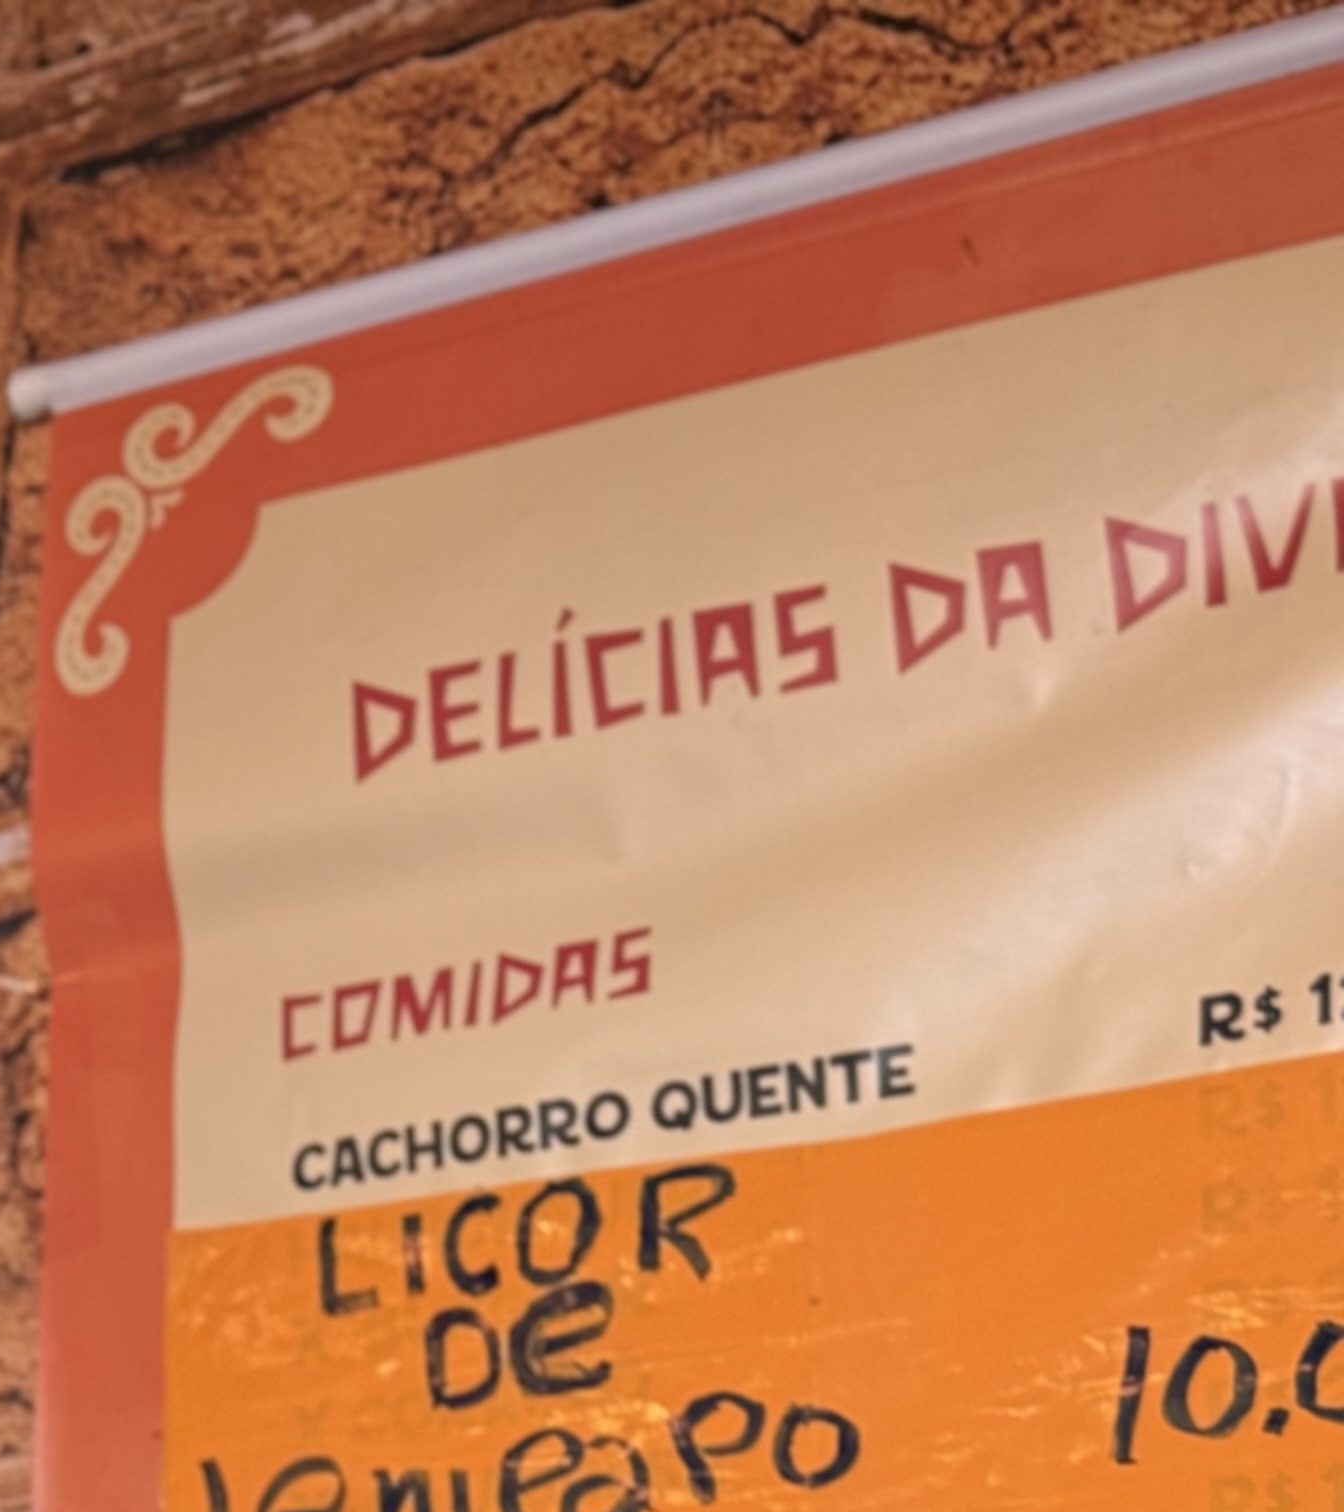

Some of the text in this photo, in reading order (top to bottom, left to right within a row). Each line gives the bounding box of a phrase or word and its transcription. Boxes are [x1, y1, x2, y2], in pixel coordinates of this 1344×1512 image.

[351, 584, 840, 783] DELÍCIAS
[887, 540, 1053, 674] DA
[279, 926, 653, 1063] COMIDAS
[1198, 972, 1344, 1047] R$ 1
[293, 1043, 916, 1190] CACHORRO QUENTE
[317, 1163, 736, 1316] LICOR
